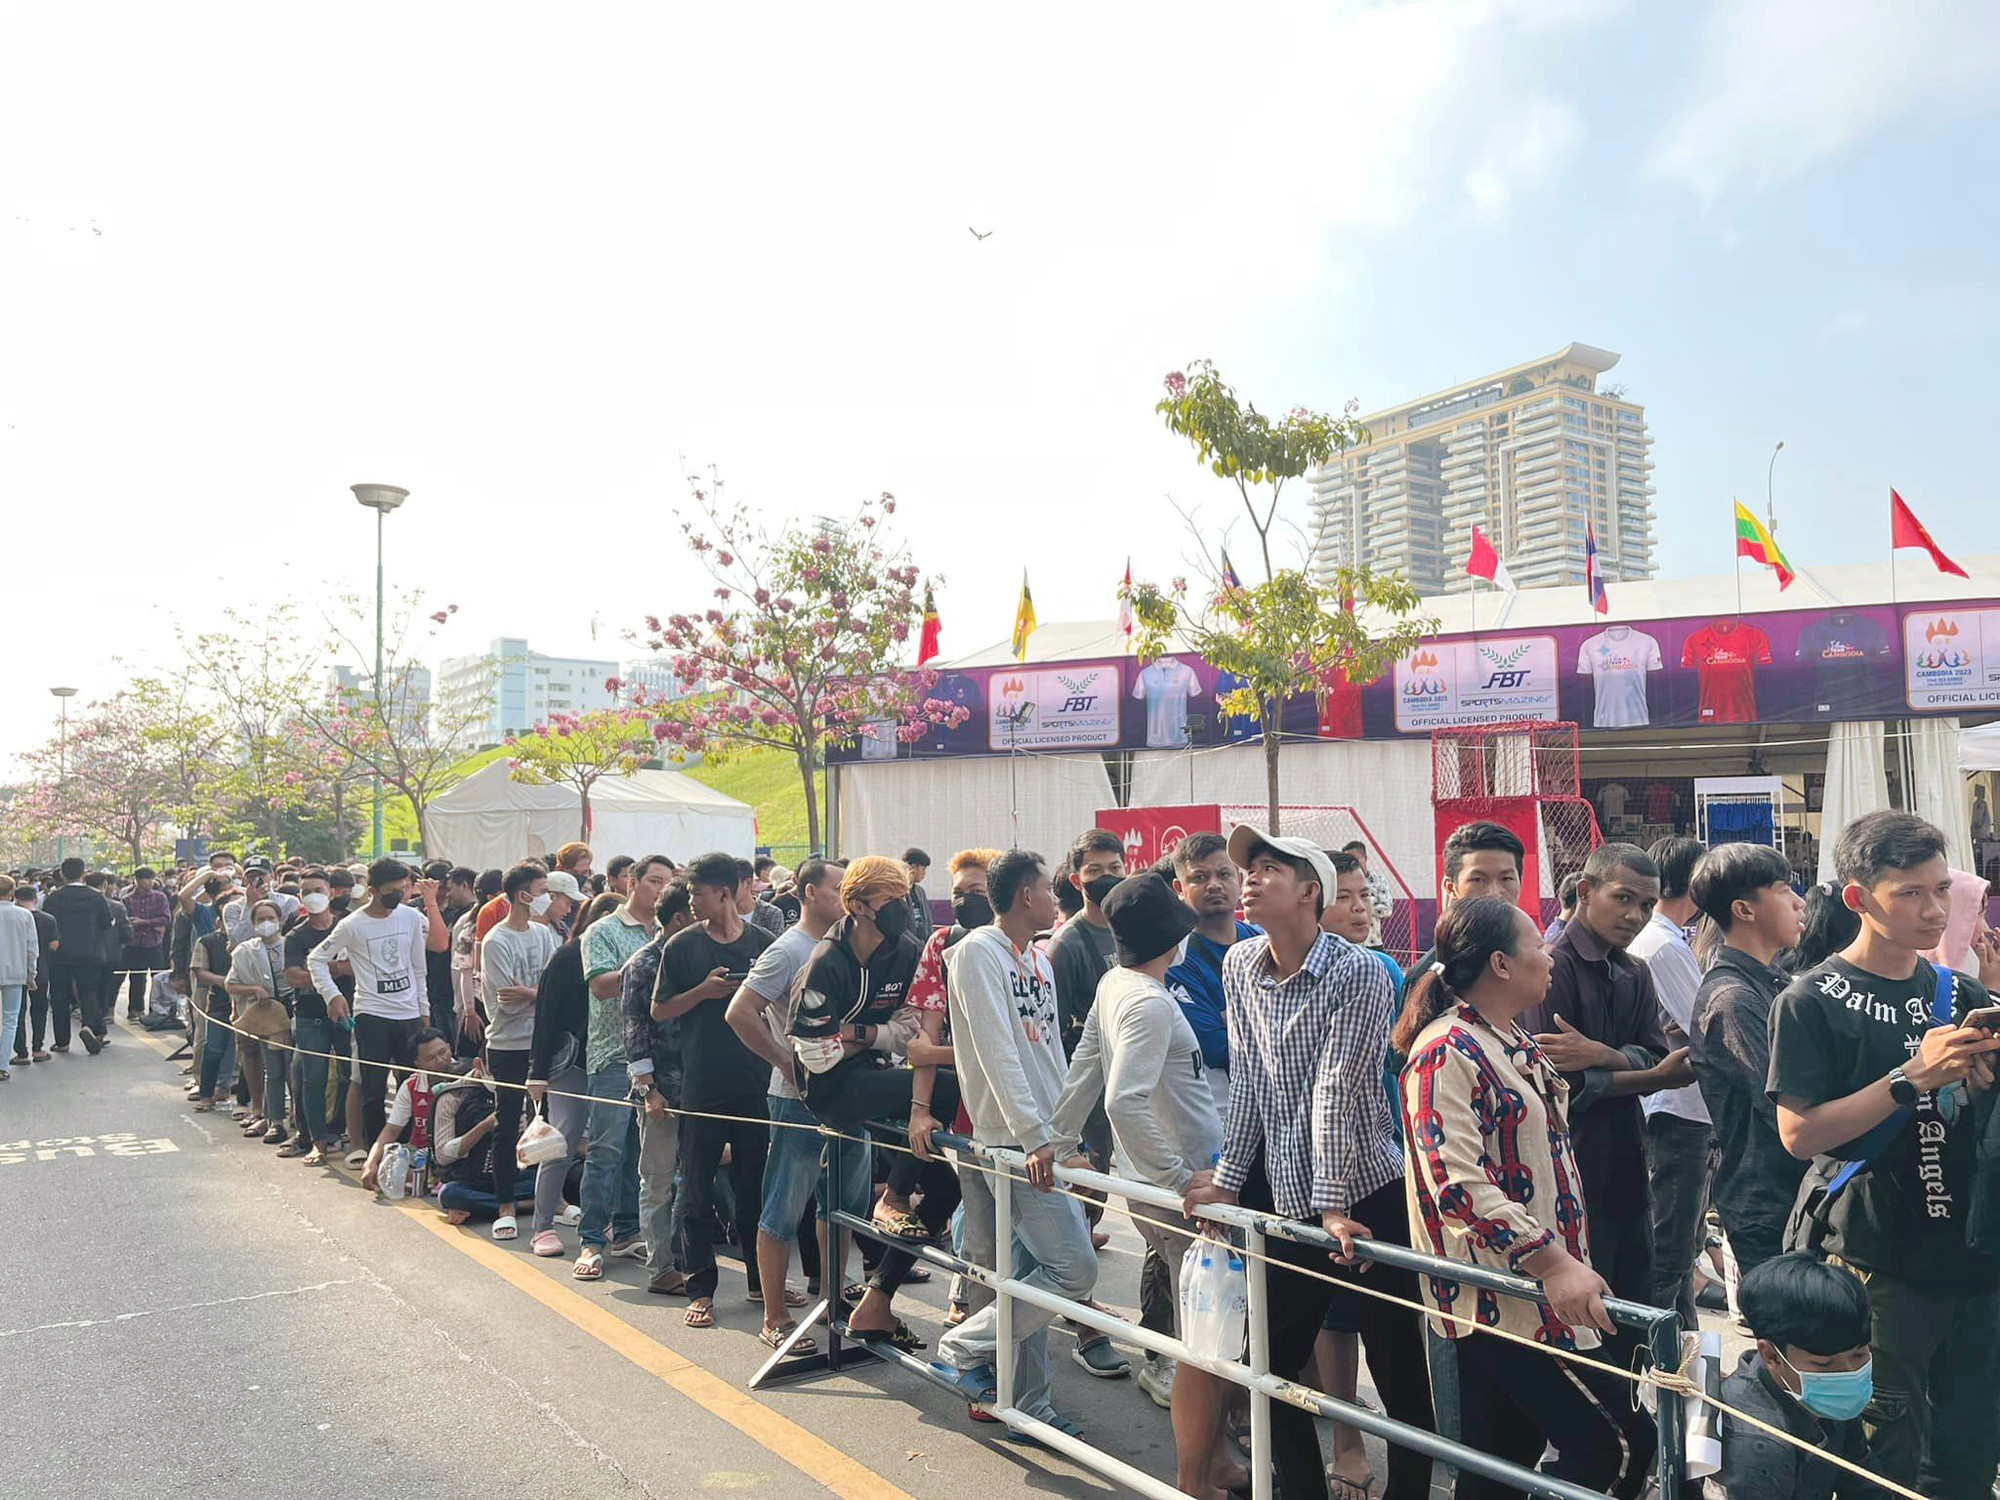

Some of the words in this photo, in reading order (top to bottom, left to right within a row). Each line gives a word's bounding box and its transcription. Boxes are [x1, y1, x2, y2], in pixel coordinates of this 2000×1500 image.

[1481, 670, 1531, 689] FBT
[1058, 696, 1098, 712] FBT
[1927, 694, 1976, 703] OFFICIAL
[1411, 717, 1451, 726] OFFICIAL
[1453, 715, 1497, 724] LICENSED
[1500, 712, 1543, 721] PRODUCT
[1002, 737, 1032, 745] OFICIAL
[1035, 735, 1070, 743] LICENSED
[1072, 734, 1107, 742] PRODUCT
[1815, 972, 1897, 1025] Palm
[1917, 1121, 1953, 1218] Angels
